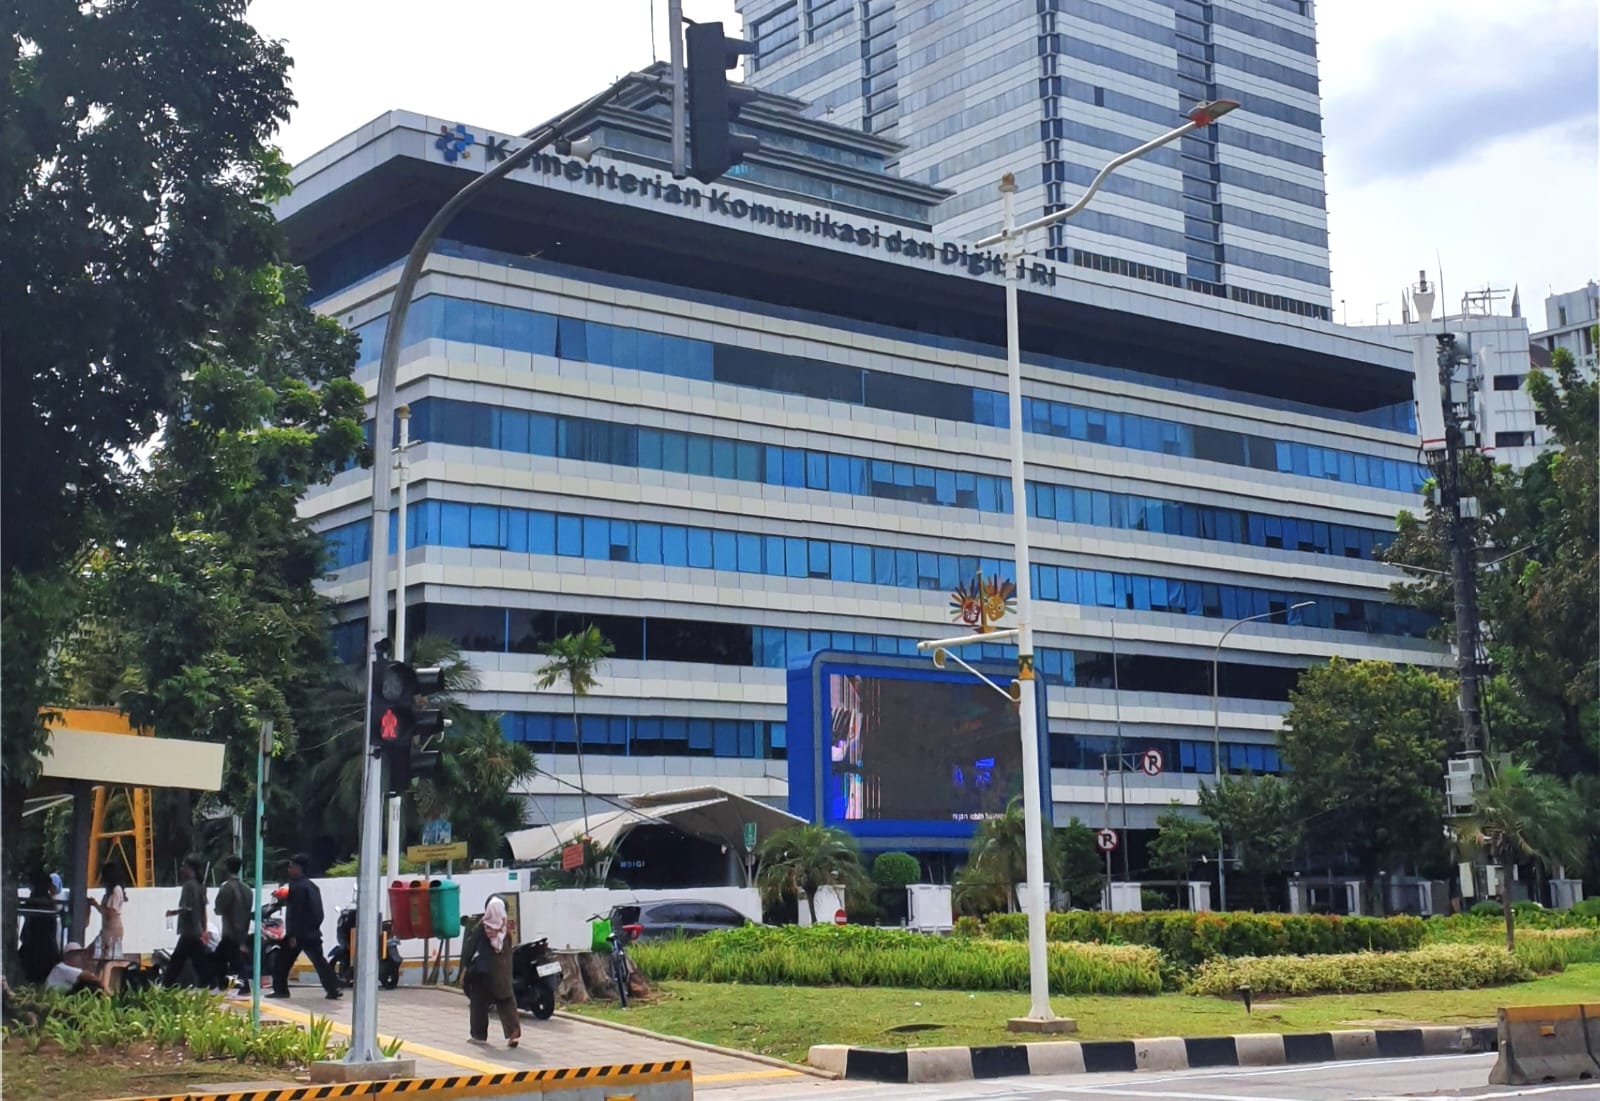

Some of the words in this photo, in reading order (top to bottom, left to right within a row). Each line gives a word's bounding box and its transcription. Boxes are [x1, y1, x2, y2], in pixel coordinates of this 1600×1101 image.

[487, 135, 701, 208] Kmenterian
[709, 187, 880, 249] Komunikasi
[885, 230, 935, 260] dan
[941, 242, 1025, 280] Digitl
[1030, 262, 1056, 287] RI
